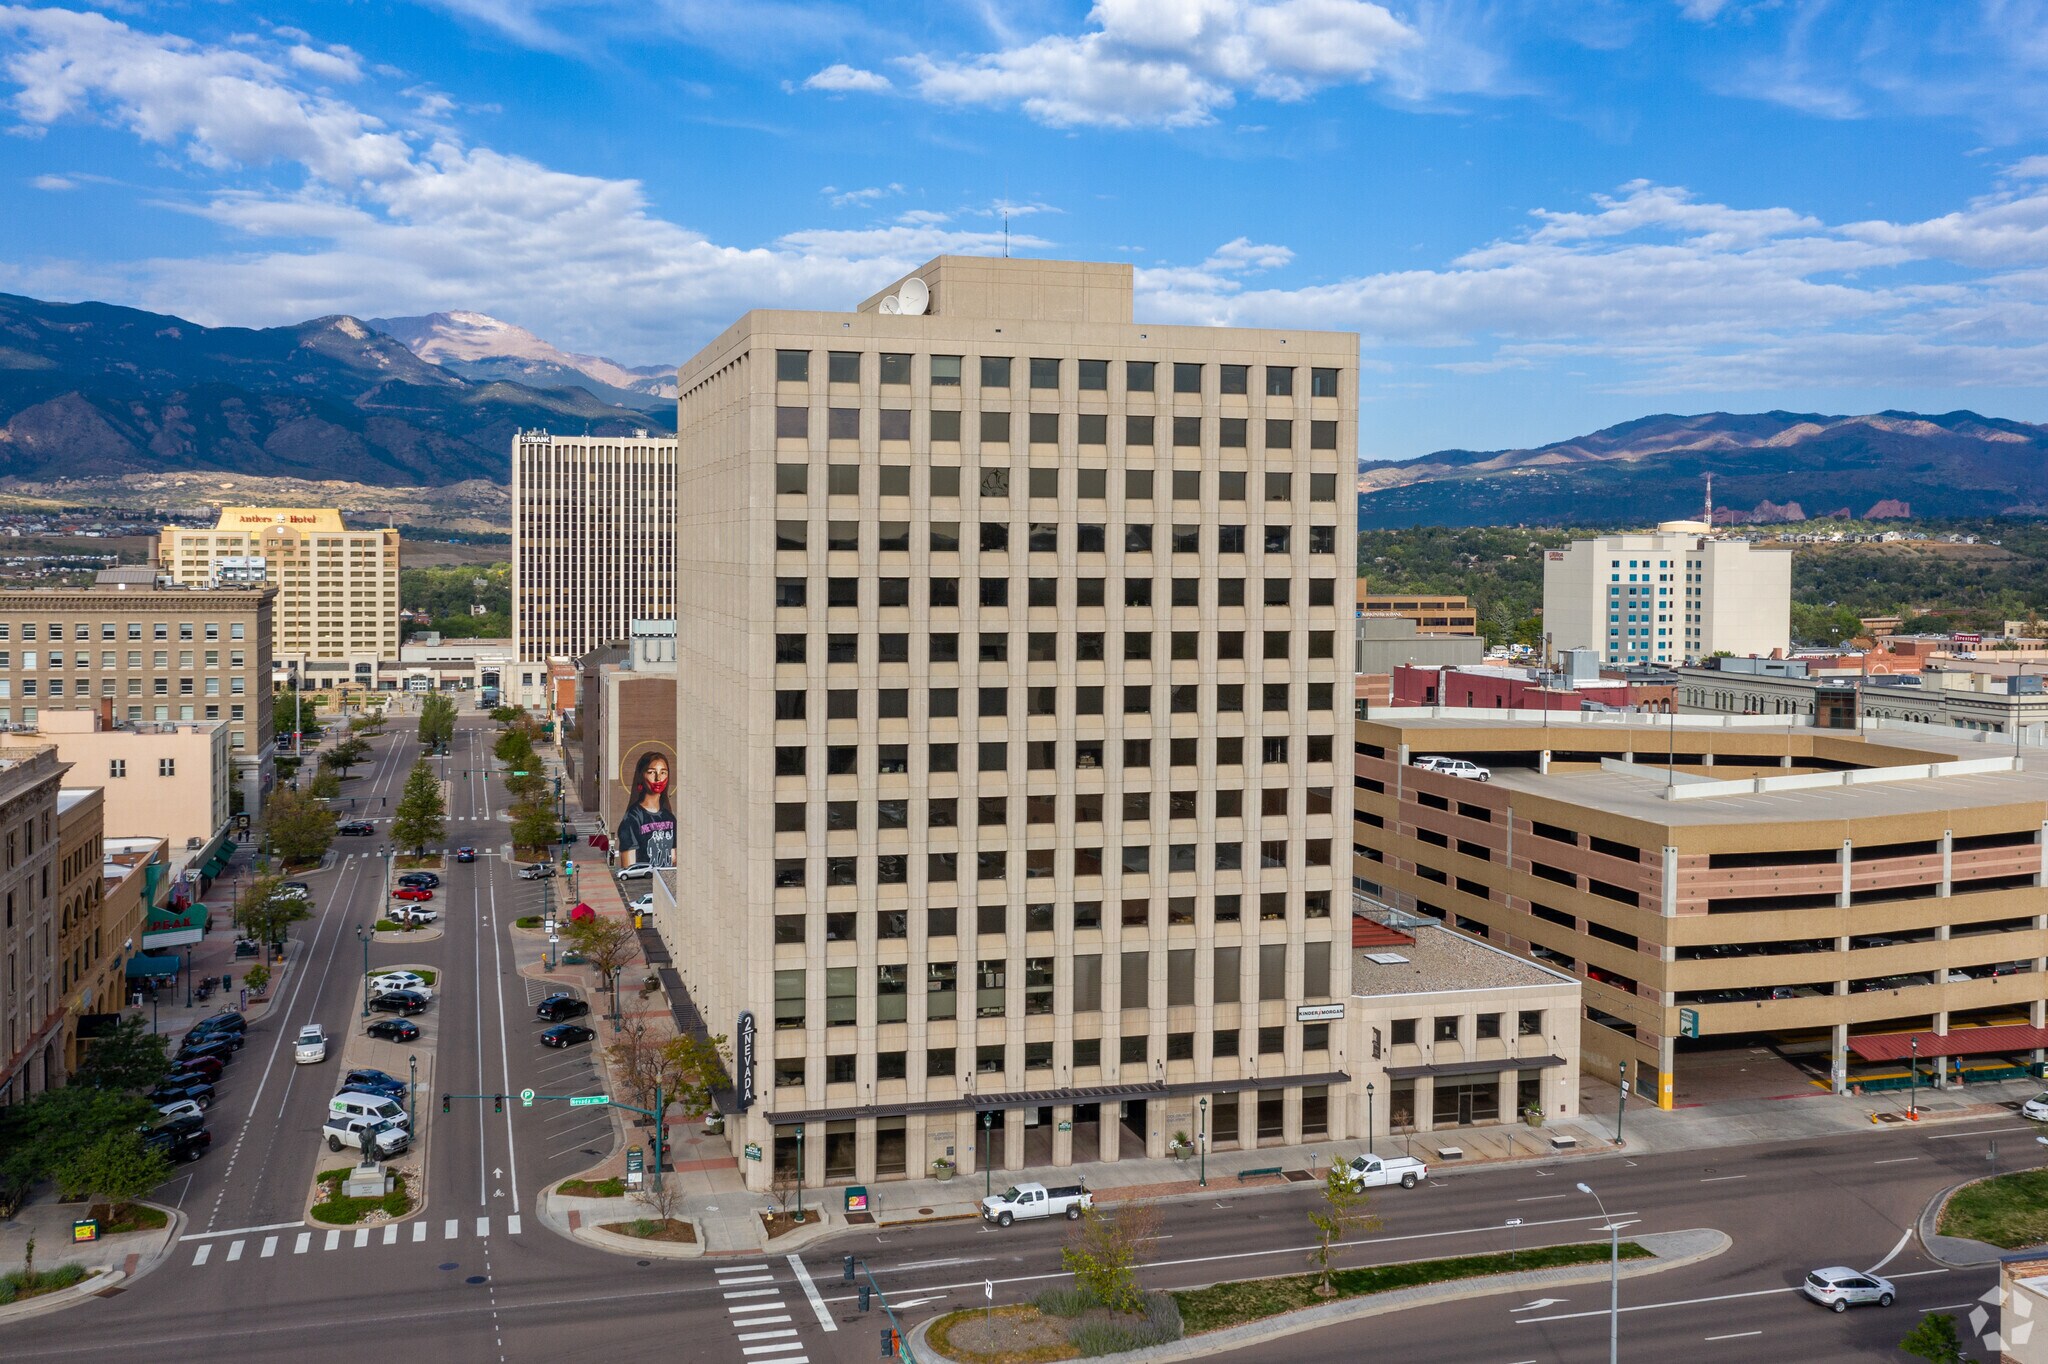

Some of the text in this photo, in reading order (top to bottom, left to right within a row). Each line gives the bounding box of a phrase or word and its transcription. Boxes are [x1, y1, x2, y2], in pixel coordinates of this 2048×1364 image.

[239, 515, 317, 523] Antlers Hotel
[152, 918, 191, 931] PEAK
[744, 1016, 752, 1032] 2
